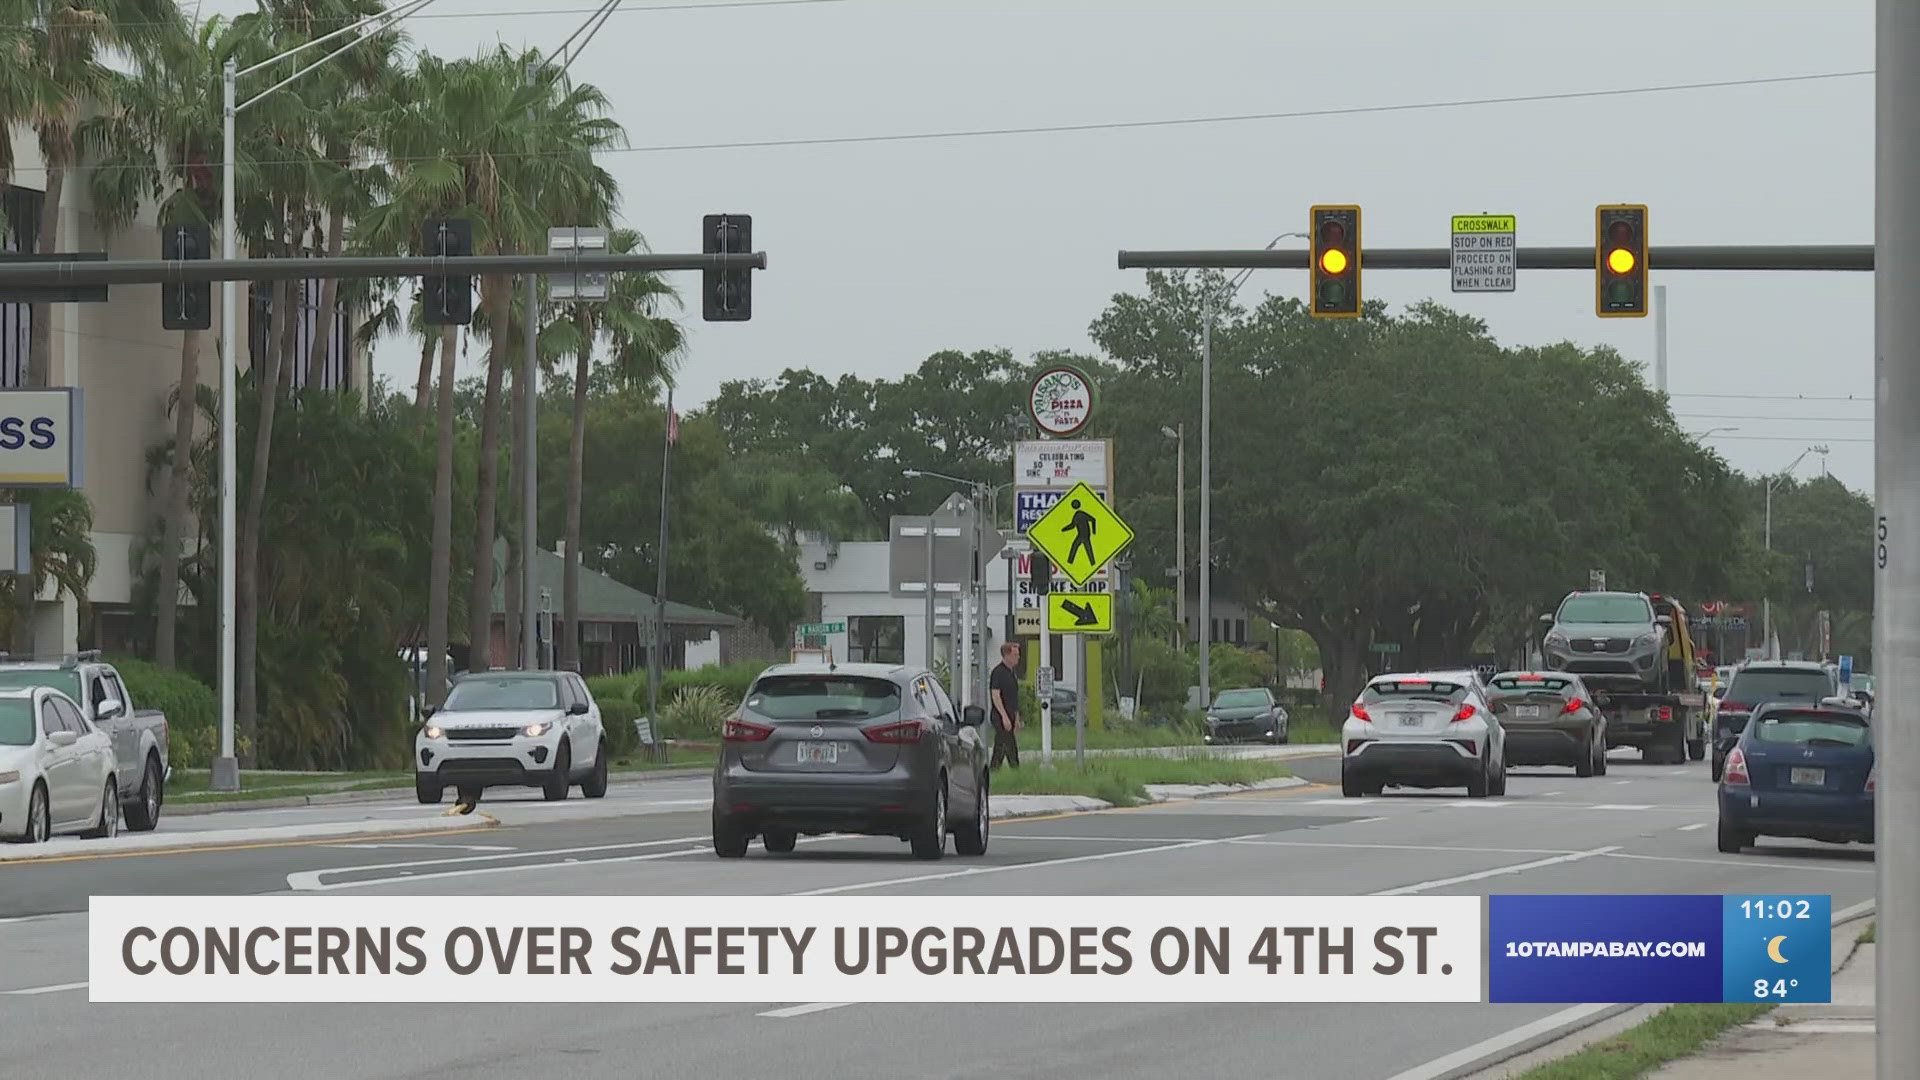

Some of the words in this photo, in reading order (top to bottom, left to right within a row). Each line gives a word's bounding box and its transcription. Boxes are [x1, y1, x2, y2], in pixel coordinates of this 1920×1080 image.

[1457, 220, 1509, 231] CROSSWALK
[1454, 237, 1477, 248] STOP
[1480, 237, 1492, 248] ON
[1495, 237, 1513, 248] RED
[1456, 254, 1495, 264] PROCEED
[1499, 254, 1511, 264] ON
[1454, 266, 1493, 276] FLASHING
[1497, 266, 1513, 276] RED
[1456, 278, 1479, 288] WHEN
[1484, 278, 1512, 288] CLEAR
[1051, 400, 1083, 410] PIZZA
[1039, 453, 1085, 461] CELEBRATING
